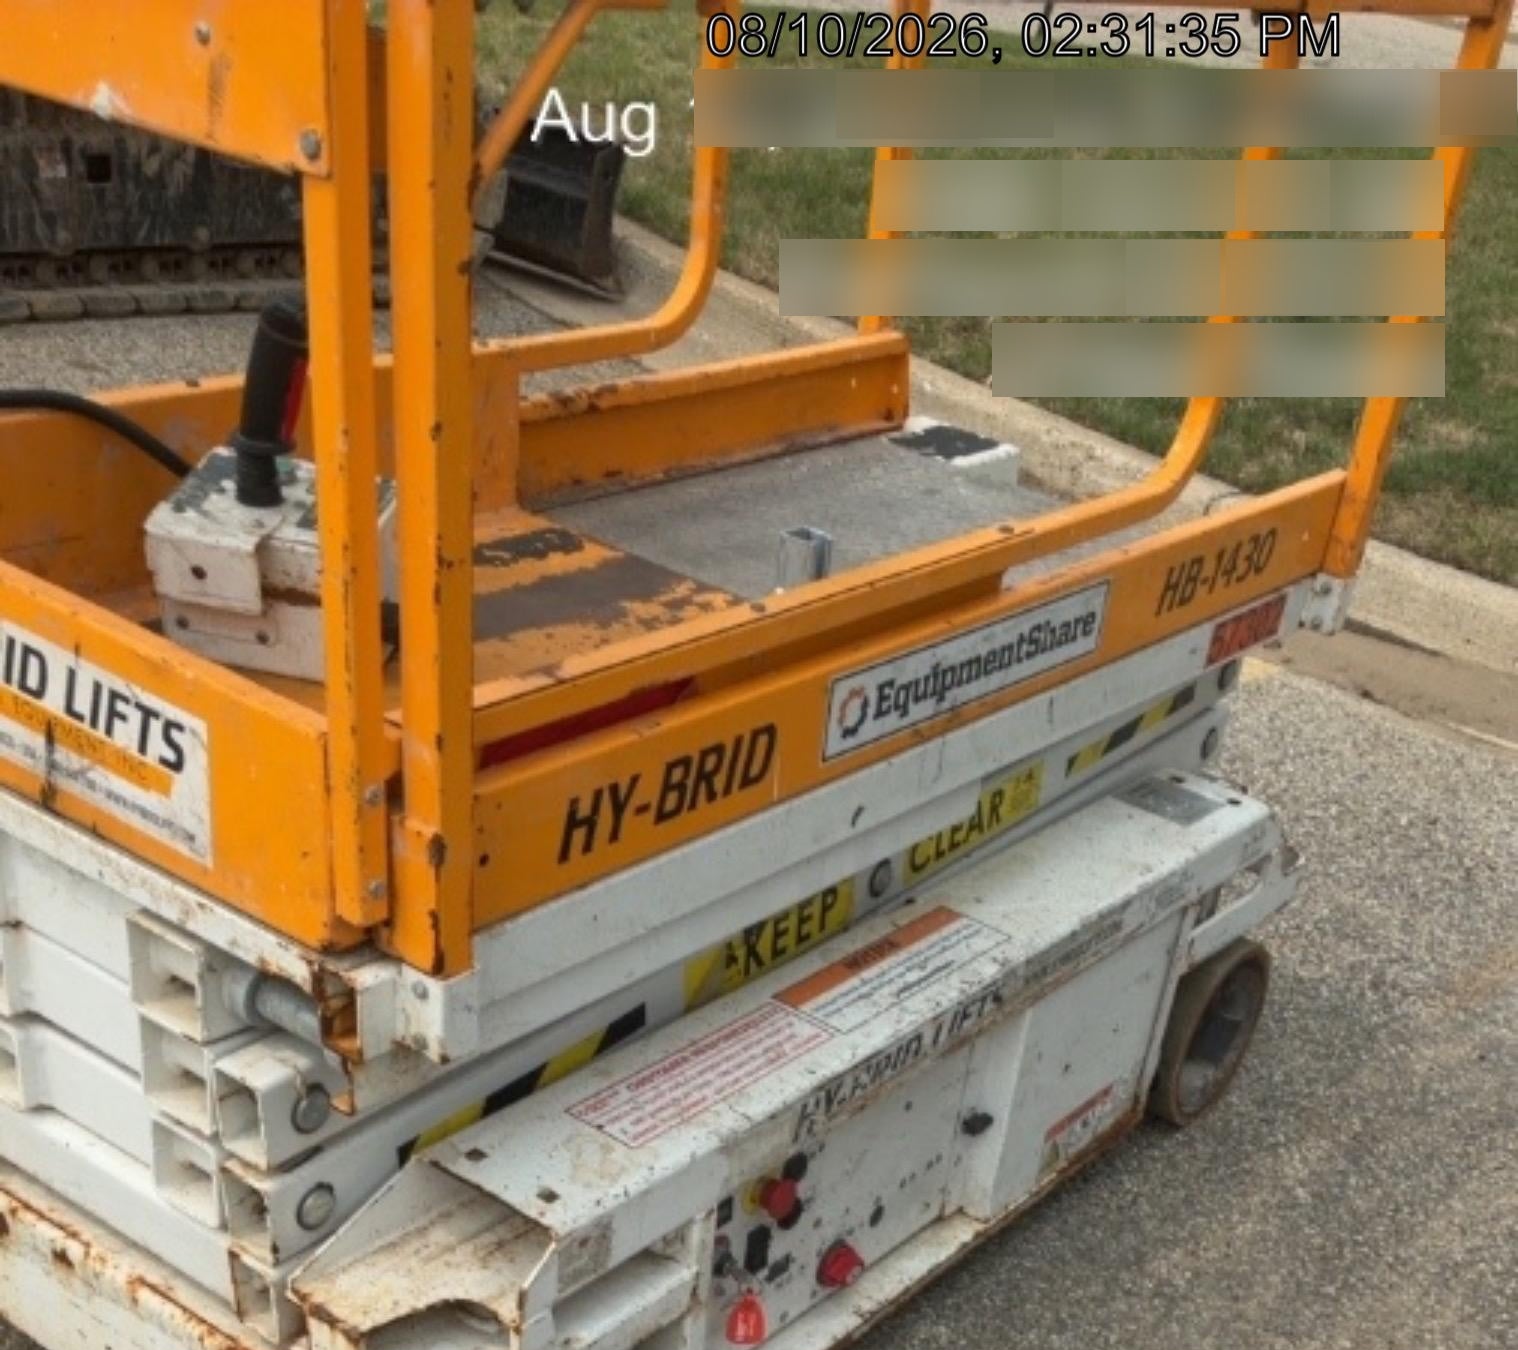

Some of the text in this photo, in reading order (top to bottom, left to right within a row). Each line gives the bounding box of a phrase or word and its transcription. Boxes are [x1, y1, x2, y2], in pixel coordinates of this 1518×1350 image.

[1155, 527, 1277, 618] HB-1430
[64, 665, 186, 774] LIFTS
[872, 610, 1097, 720] EquipmentShare
[557, 722, 777, 865] HY-BRID
[741, 886, 839, 977] KEEP
[909, 788, 1006, 874] CLEAR
